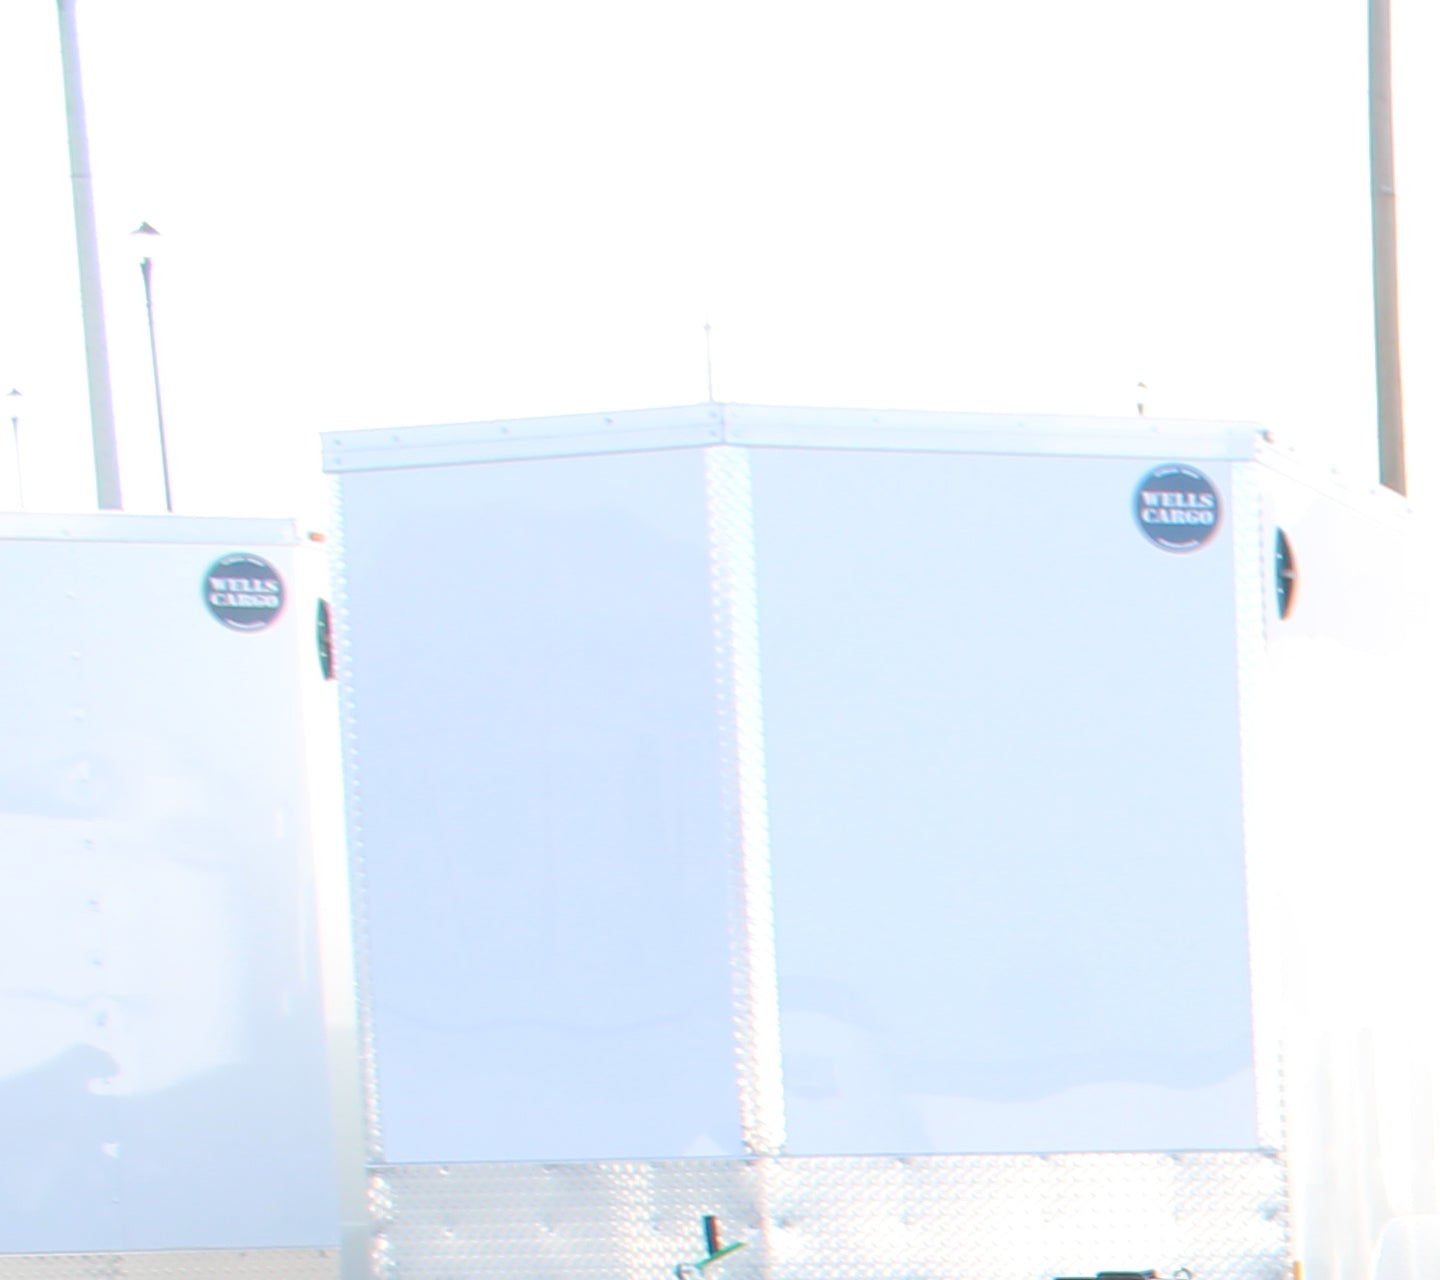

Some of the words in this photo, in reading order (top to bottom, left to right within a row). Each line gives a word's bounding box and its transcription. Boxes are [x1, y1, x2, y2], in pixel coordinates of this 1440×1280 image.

[1140, 490, 1216, 508] WELLS
[1140, 508, 1215, 526] CARGO
[208, 577, 280, 593] WELLS
[208, 593, 280, 608] CARGO
